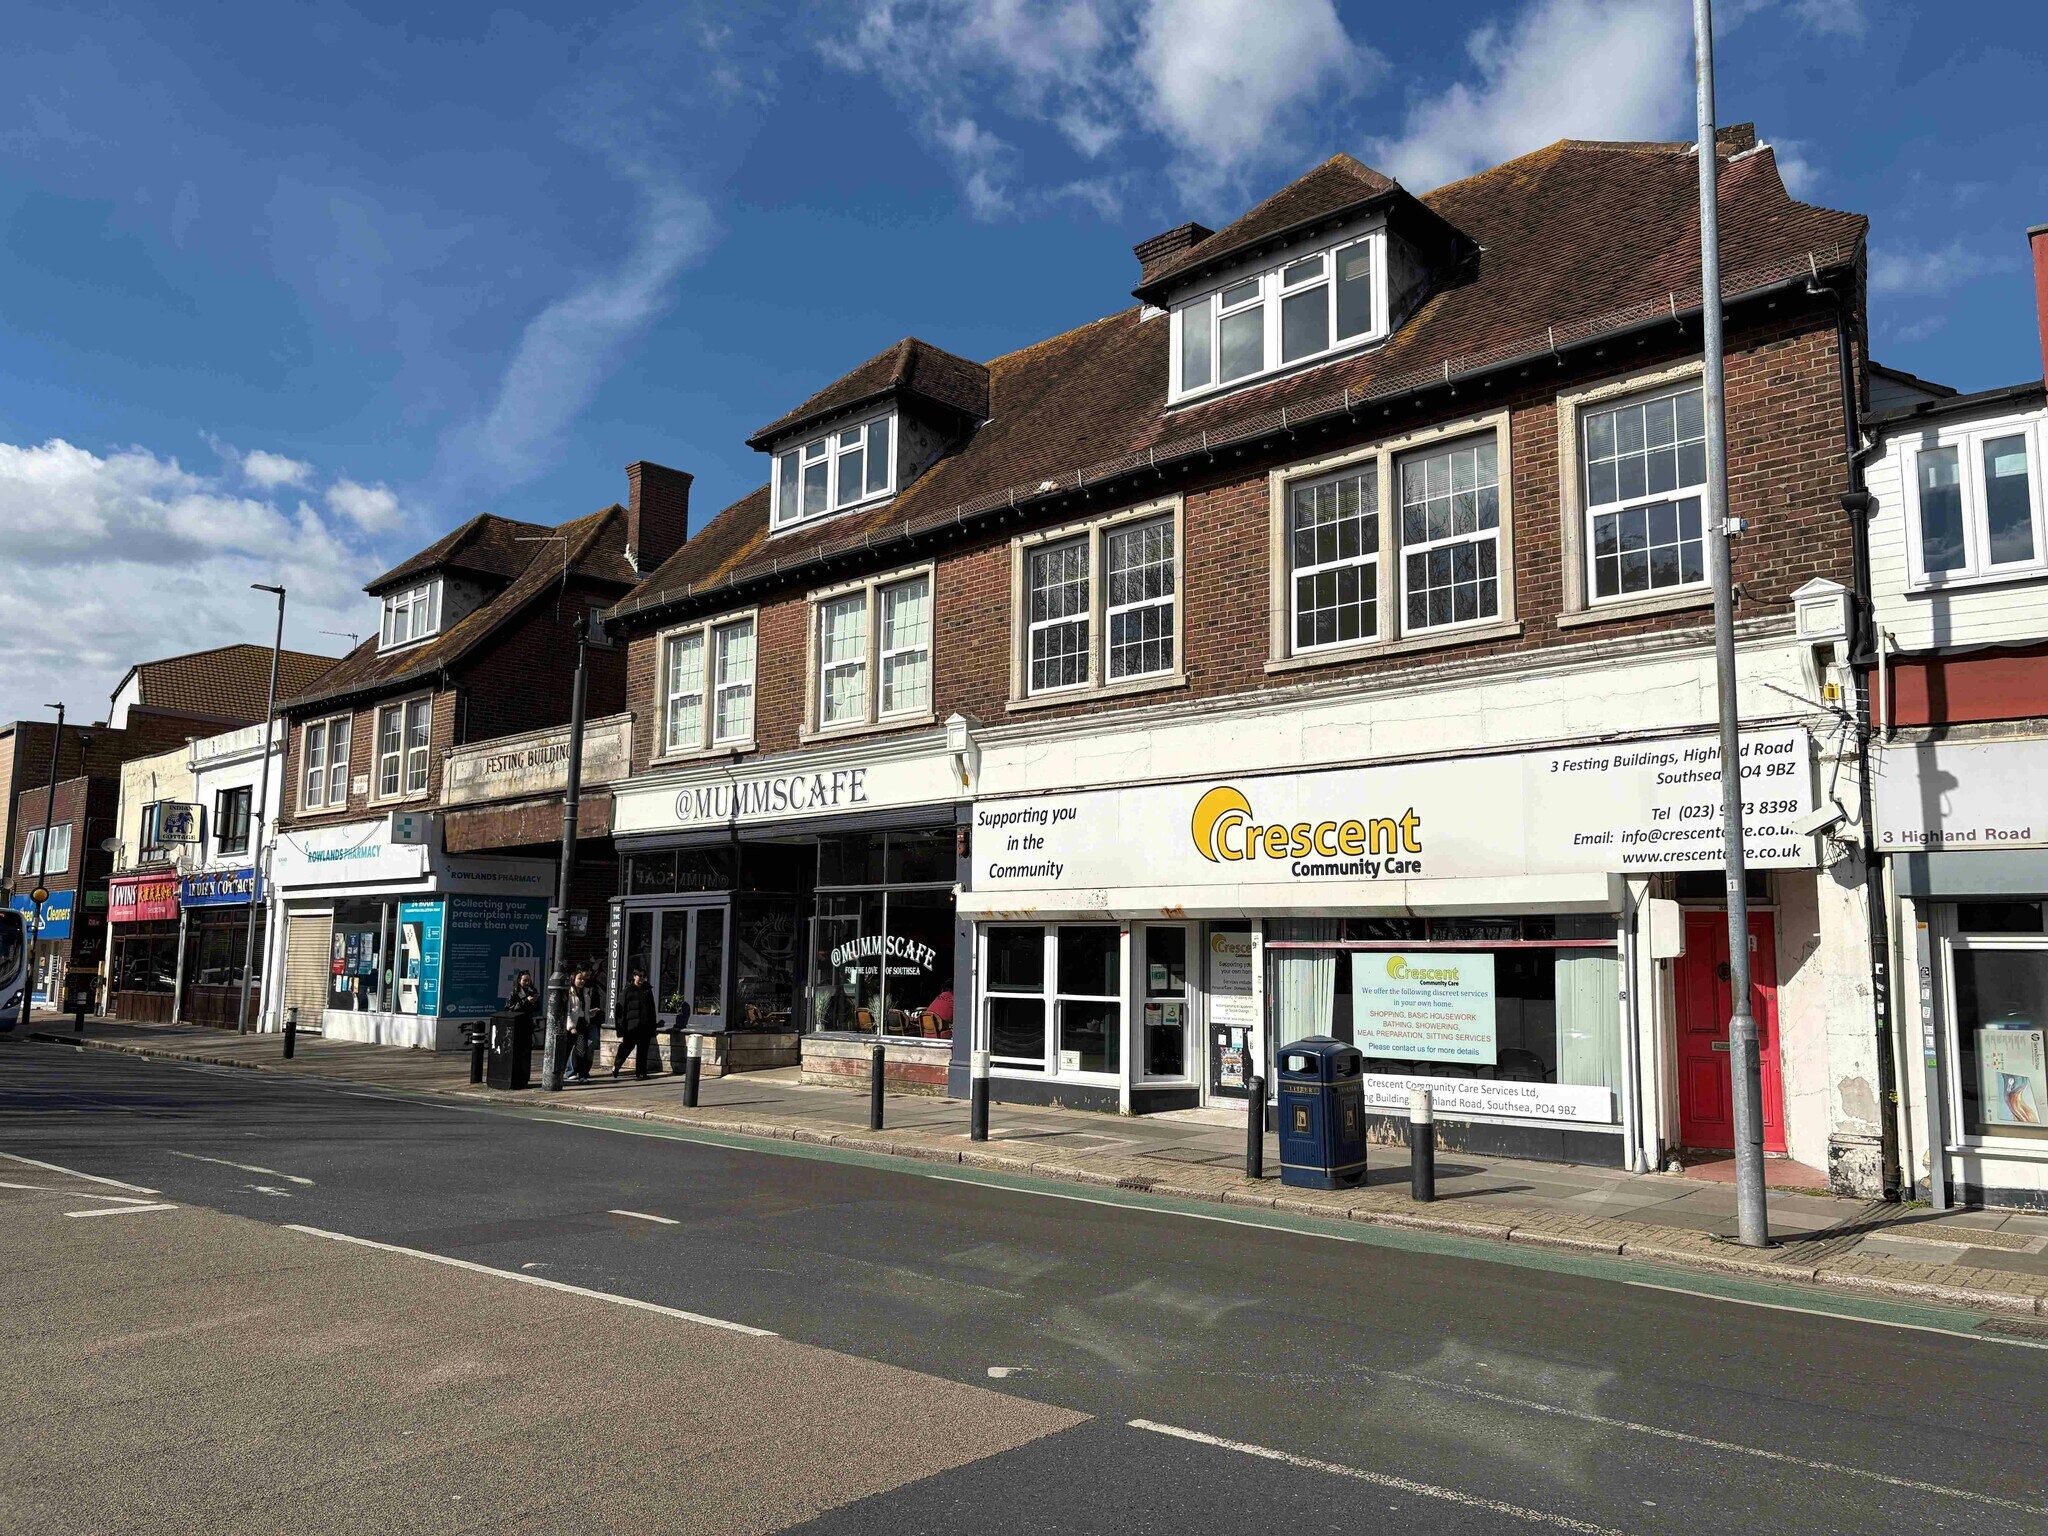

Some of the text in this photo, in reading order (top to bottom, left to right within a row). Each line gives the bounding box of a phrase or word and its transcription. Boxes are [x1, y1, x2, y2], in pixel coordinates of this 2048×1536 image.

[486, 752, 524, 774] FESTING
[1551, 739, 1794, 773] 3 Festing Buildings, Highld Road
[1739, 765, 1761, 779] O4
[1766, 762, 1796, 777] 9BZ
[675, 767, 869, 822] @MUMMSCAFE
[978, 807, 1077, 829] Supporting you
[1652, 807, 1671, 820] Tel
[1679, 804, 1715, 822] (023)
[1759, 800, 1798, 814] 8398
[1007, 833, 1044, 851] in the
[1217, 807, 1422, 861] Crescent
[1573, 831, 1614, 845] Email:
[1883, 827, 2031, 845] 3 Highland Road
[308, 845, 381, 863] ROWLANDS PHARMACY
[451, 871, 542, 882] ROWLANDS PHARMACY
[989, 860, 1064, 880] Community
[1291, 857, 1422, 879] Community Care
[1730, 881, 1734, 889] 1
[46, 905, 70, 921] Cleaners
[453, 899, 527, 911] Collecting your
[452, 910, 512, 920] prescription
[514, 910, 521, 919] is
[452, 920, 481, 928] easier
[485, 920, 506, 929] than
[831, 935, 937, 972] @MUMMSCAFE
[1218, 940, 1252, 954] Cresce
[609, 939, 618, 1019] SOUTHSEA
[865, 966, 878, 975] LOVE
[886, 966, 893, 975] OF
[893, 966, 920, 976] SOUTHSEA
[1395, 964, 1460, 980] Crescent
[1361, 986, 1373, 994] We
[1373, 987, 1389, 995] offer
[1390, 987, 1400, 995] the
[1401, 988, 1431, 997] following
[1433, 989, 1459, 997] discreet
[1369, 1010, 1406, 1019] SHOPPING,
[1429, 1013, 1477, 1021] HOUSEWORK
[1383, 1021, 1461, 1031] BATHING, SHOWERING,
[1357, 1029, 1492, 1042] MEAL PREPARATION, SITTING SERVICES
[1368, 1042, 1391, 1051] Please
[1392, 1045, 1415, 1053] contact
[1426, 1045, 1437, 1053] for
[1457, 1047, 1480, 1056] details
[1367, 1078, 1404, 1090] Crescent
[1406, 1080, 1456, 1094] Community
[1458, 1083, 1479, 1093] Care
[1481, 1084, 1519, 1096] Services
[1521, 1087, 1539, 1099] Ltd,
[1459, 1098, 1485, 1110] Road,
[1487, 1100, 1533, 1114] Southsea,
[1535, 1103, 1556, 1114] PO4
[1557, 1105, 1577, 1116] 9BZ
